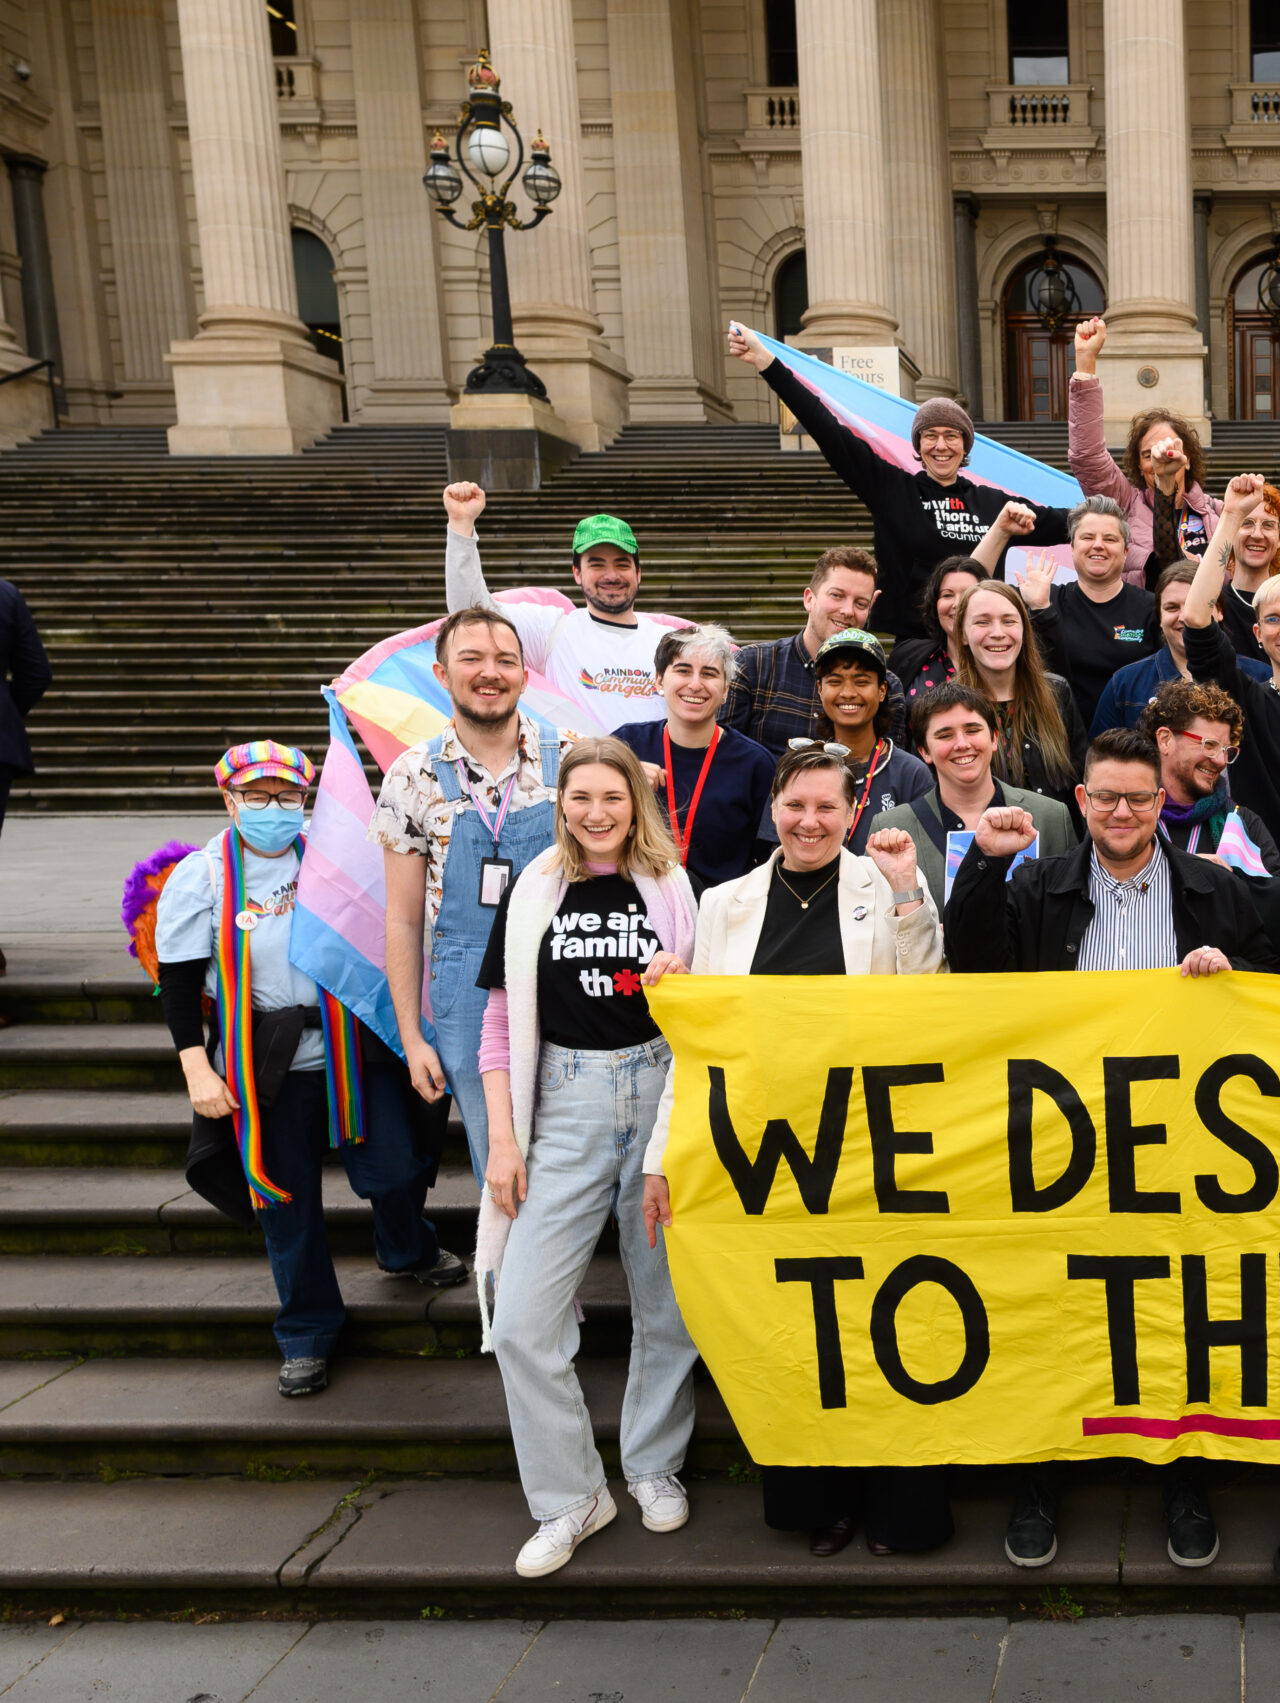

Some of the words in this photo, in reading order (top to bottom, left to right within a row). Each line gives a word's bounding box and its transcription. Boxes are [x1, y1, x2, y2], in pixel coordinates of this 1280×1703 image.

[841, 355, 874, 369] Free
[594, 672, 657, 687] Communi
[604, 667, 652, 678] RAINBOW
[272, 881, 298, 897] RAINB
[552, 912, 602, 933] we
[550, 931, 659, 964] family
[708, 1062, 949, 1216] WE
[775, 1255, 990, 1409] TO
